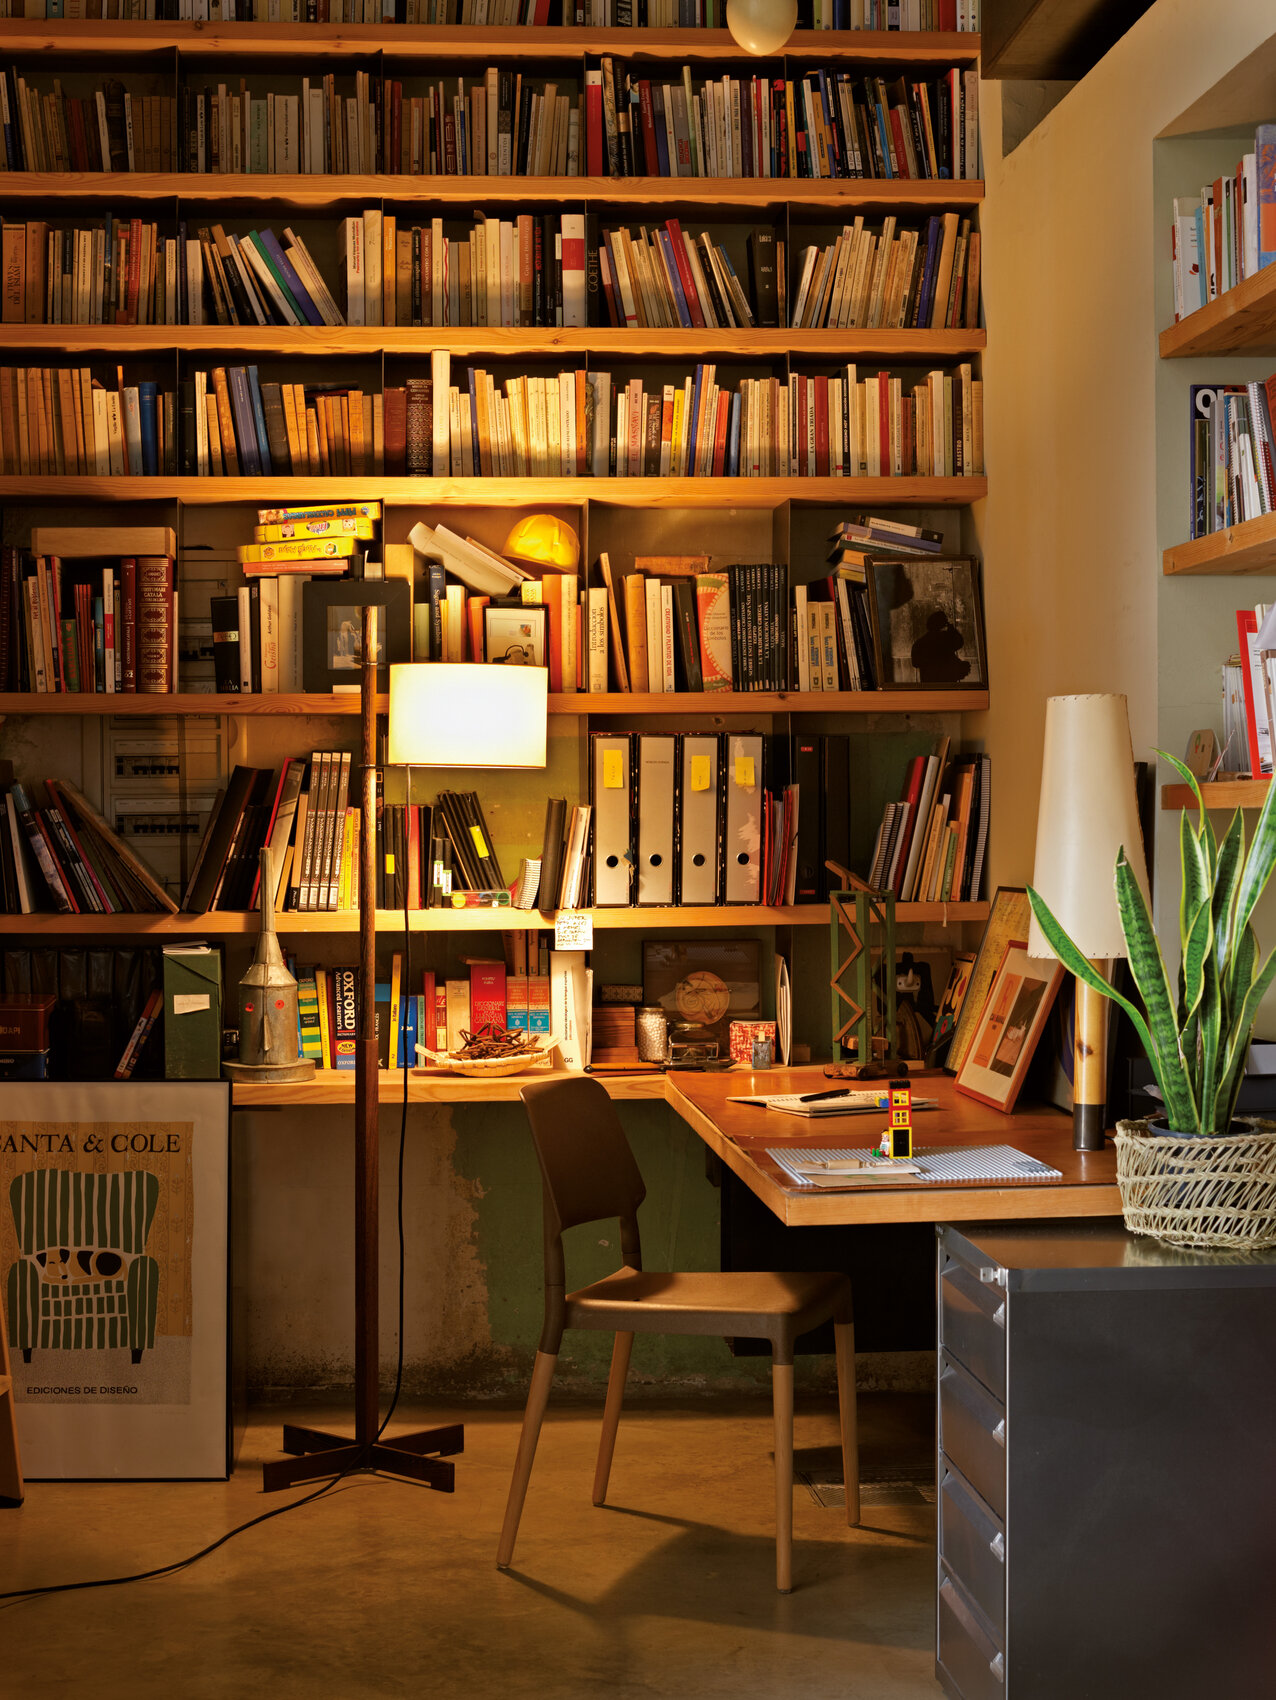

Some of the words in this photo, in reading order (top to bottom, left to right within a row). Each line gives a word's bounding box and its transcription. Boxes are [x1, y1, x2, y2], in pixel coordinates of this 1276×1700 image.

[588, 249, 598, 292] GOETHE
[342, 970, 356, 1030] OXFORD
[0, 1134, 75, 1153] ANTA
[83, 1134, 104, 1153] &
[110, 1134, 181, 1153] COLE
[26, 1386, 81, 1394] EDICIONES
[84, 1386, 98, 1394] DE
